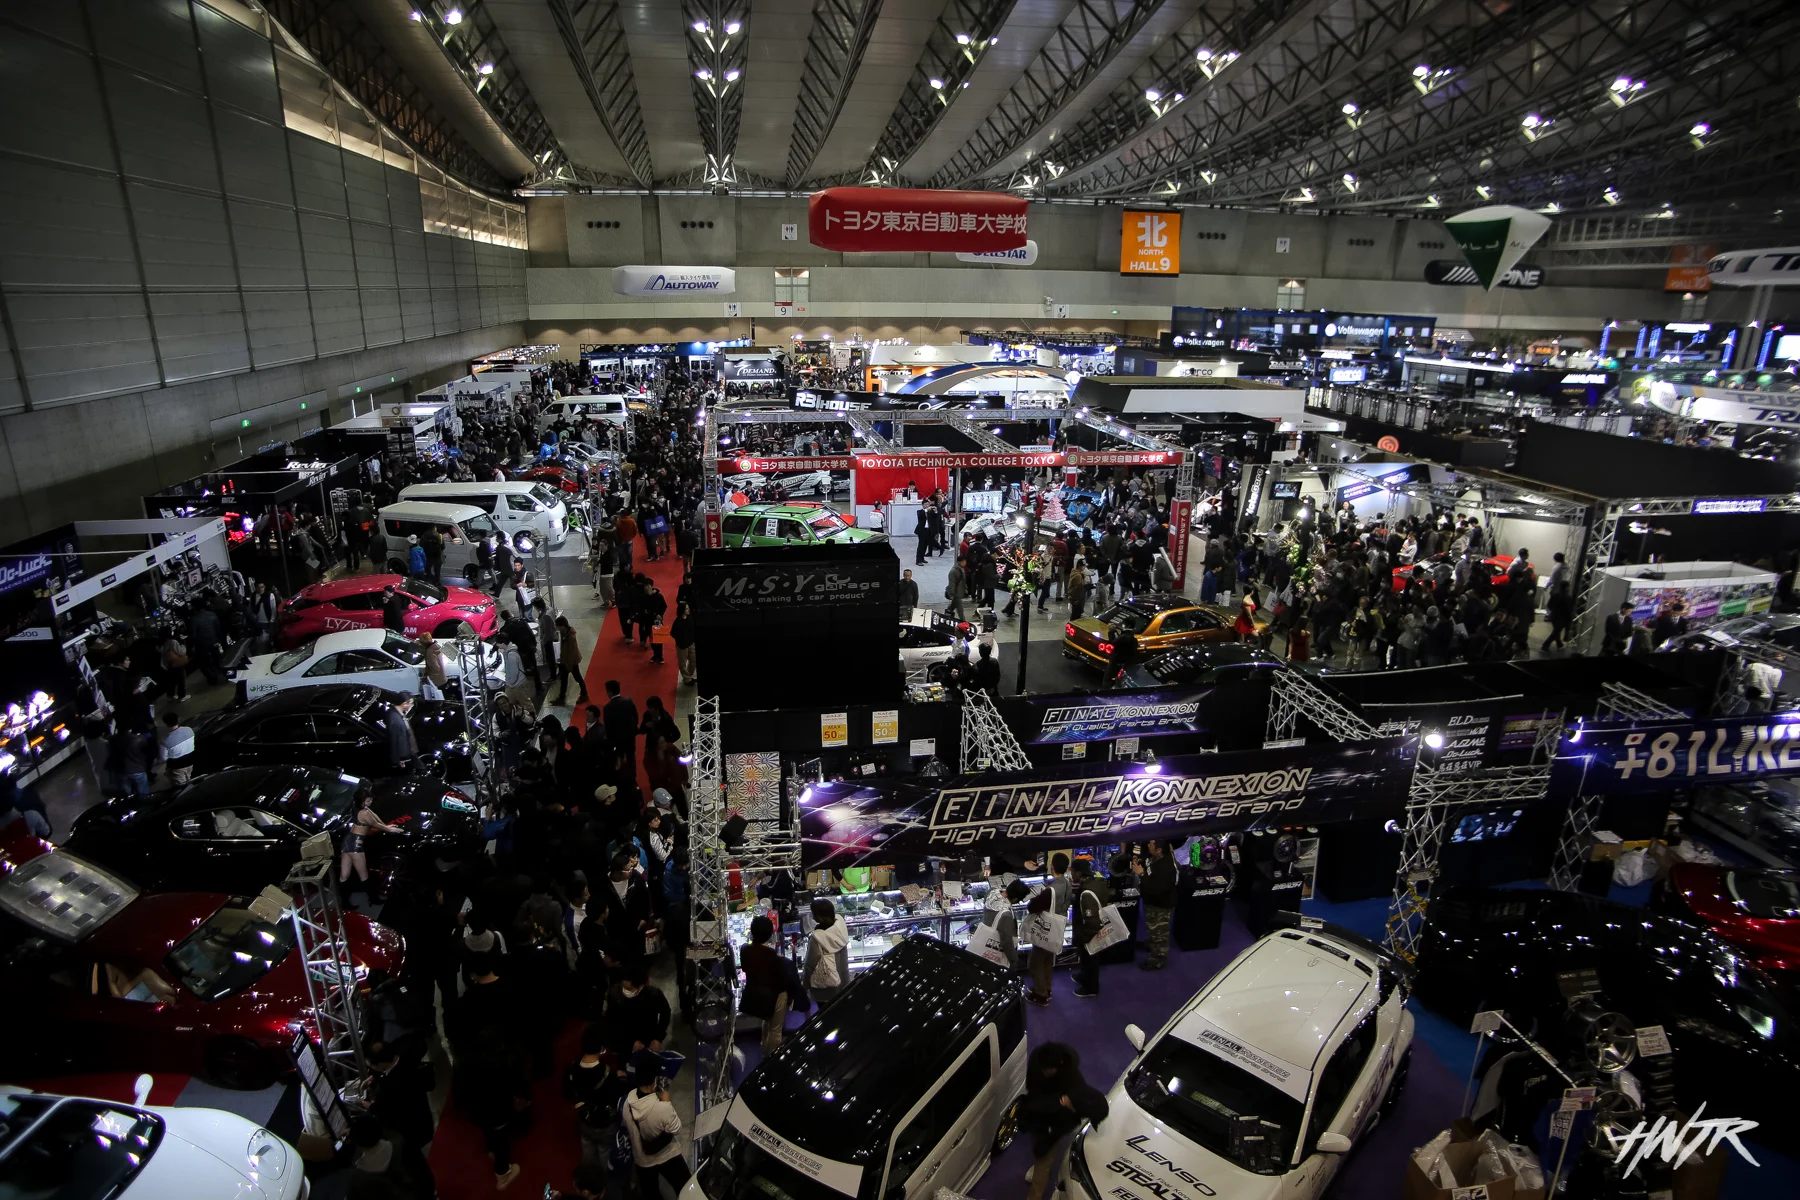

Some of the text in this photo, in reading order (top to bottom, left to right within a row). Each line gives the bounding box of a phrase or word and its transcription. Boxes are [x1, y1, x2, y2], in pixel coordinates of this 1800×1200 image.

[825, 208, 1027, 235] トヨタ東京自動車大学校
[1137, 215, 1168, 248] 北
[1138, 248, 1164, 256] NORTH
[1129, 256, 1171, 271] HALL 9
[664, 281, 720, 290] AUTOWAY
[780, 306, 787, 316] 9
[1337, 325, 1384, 337] Volkswagen
[1184, 337, 1225, 347] Volkswagen
[753, 459, 848, 471] トヨタ東京自動車大学校
[861, 455, 1056, 469] TOYOTA TECHNICAL COLLEGE TOKYO
[1079, 454, 1164, 464] トヨタ東京自動車大学校
[730, 597, 753, 605] body
[758, 594, 792, 603] making
[829, 592, 866, 600] product
[1041, 704, 1120, 726] FINAL
[1040, 715, 1197, 734] High Quality Parts Brand
[824, 730, 838, 739] 50
[875, 728, 888, 737] 50
[929, 768, 1313, 830] FINAL KONNEXION
[928, 796, 1306, 846] High Quality Parts Brand
[1124, 1134, 1217, 1197] LENSO
